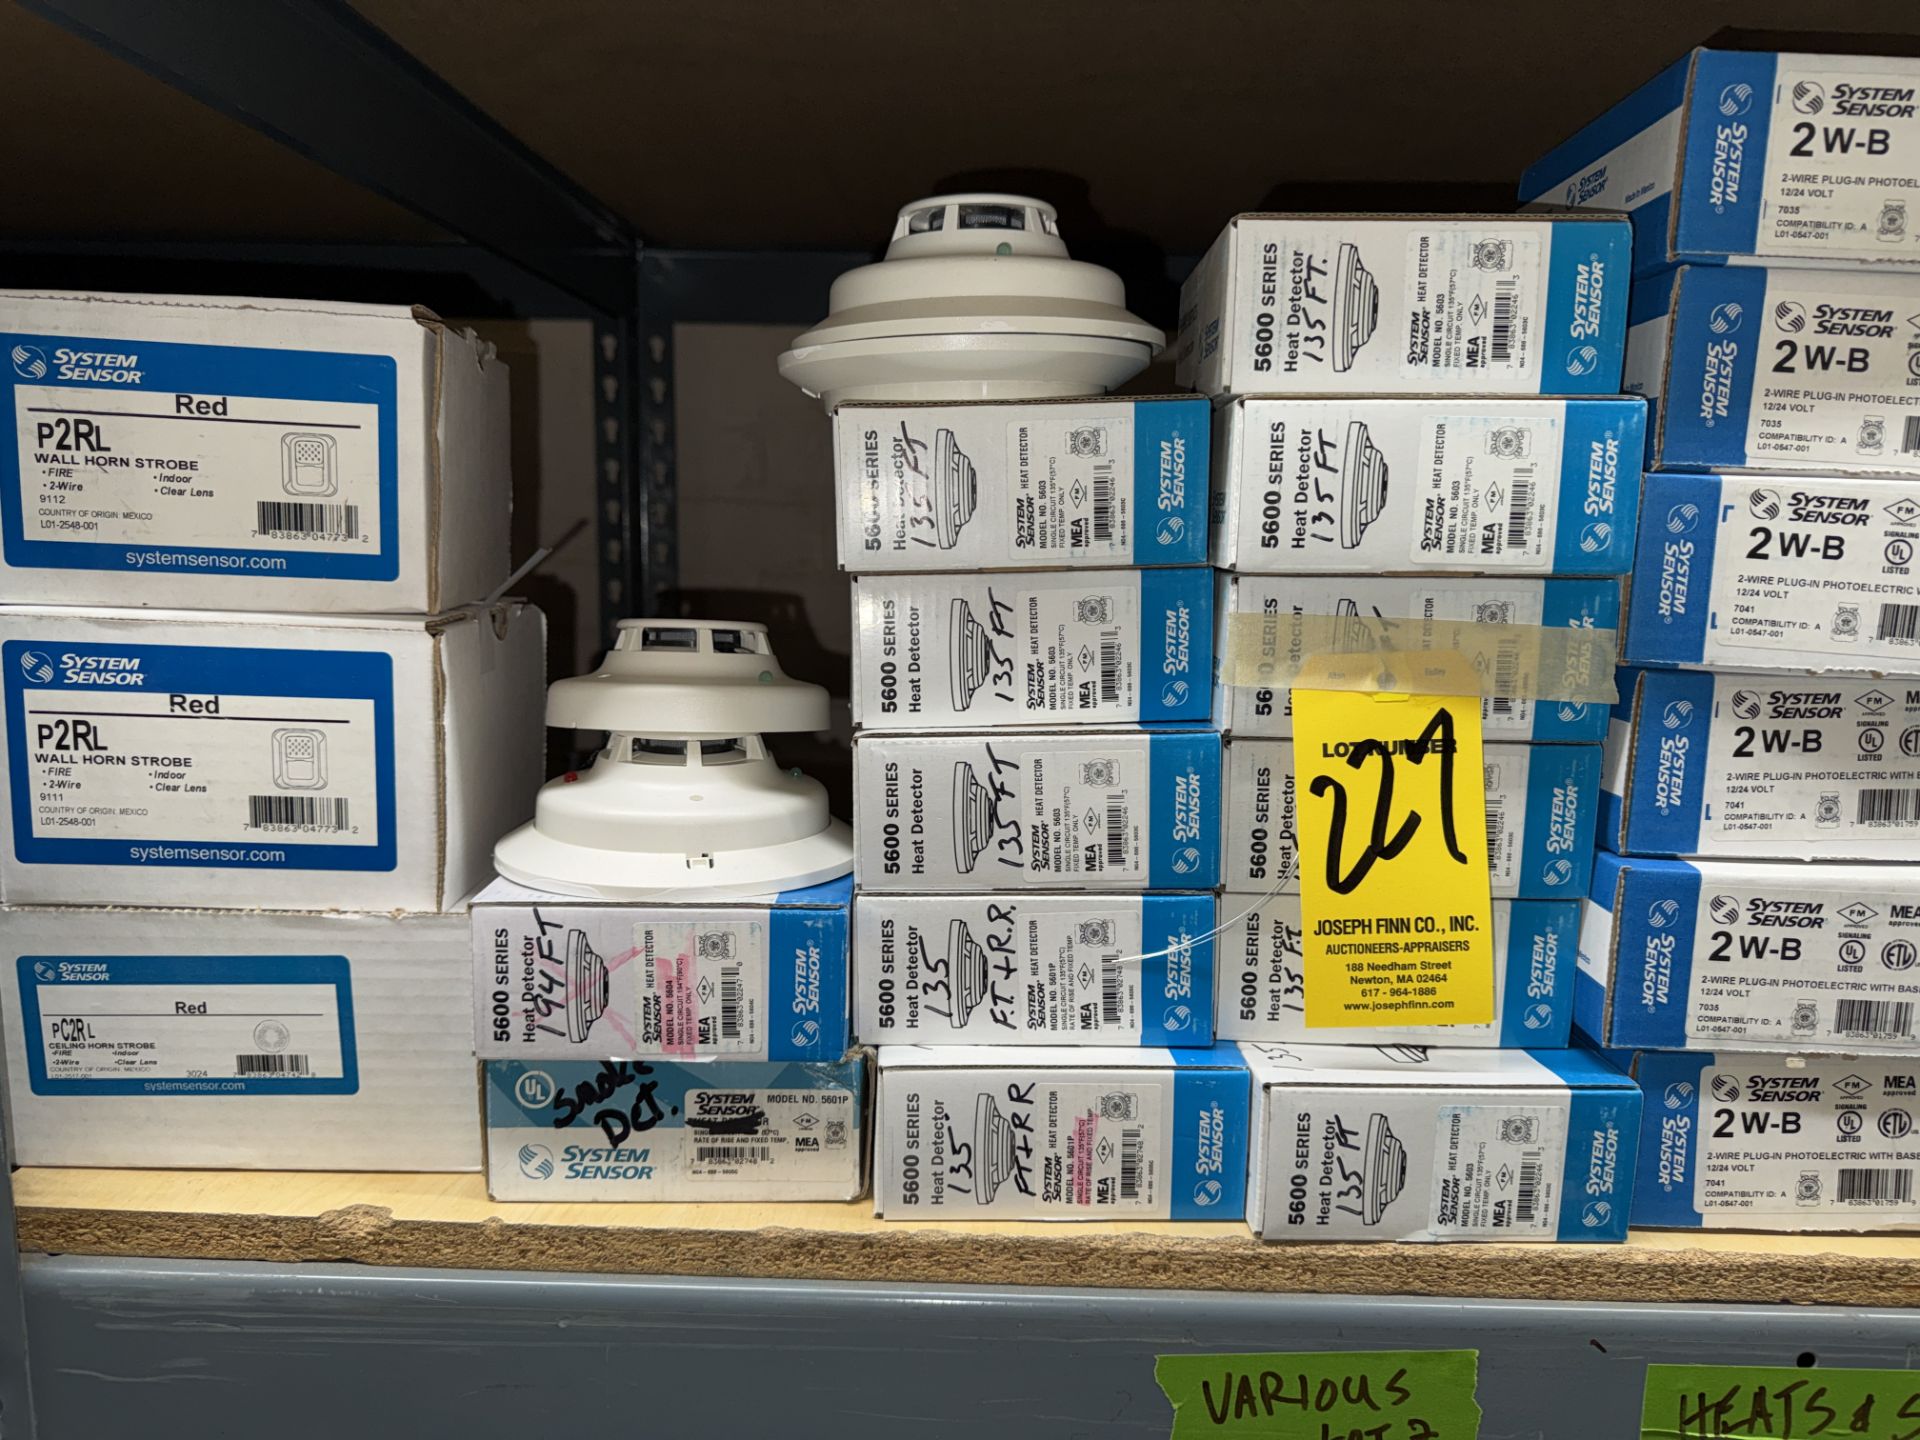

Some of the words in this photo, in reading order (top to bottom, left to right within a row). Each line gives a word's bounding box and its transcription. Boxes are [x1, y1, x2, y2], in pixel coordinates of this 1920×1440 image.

[1831, 84, 1914, 101] SYSTEM
[1832, 101, 1914, 118] SENSOR
[1260, 242, 1277, 306] SERIES
[1286, 250, 1303, 331] Detector
[1570, 263, 1589, 341] SYSTEM
[1586, 261, 1604, 338] SENSOR
[1813, 304, 1893, 322] SYSTEM
[1814, 319, 1894, 338] SENSOR
[1253, 311, 1272, 372] 5600
[1284, 336, 1299, 372] Heat
[53, 348, 139, 368] SYSTEM
[57, 365, 141, 384] SENSOR
[175, 395, 228, 416] Red
[37, 418, 111, 453] P2RL
[1313, 429, 1339, 474] FT
[34, 453, 80, 466] WALL
[85, 456, 130, 468] HORN
[135, 458, 199, 471] STROBE
[1268, 421, 1286, 484] SERIES
[1294, 428, 1311, 508] Detector
[1157, 440, 1175, 512] SYSTEM
[1173, 438, 1186, 509] SENSOR
[39, 495, 66, 505] 9112
[160, 486, 186, 497] Clear
[190, 488, 214, 498] Lens
[1788, 492, 1870, 510] SYSTEM
[38, 508, 76, 518] COUNTRY
[78, 510, 89, 518] OF
[123, 512, 152, 521] MEXICO
[1261, 489, 1279, 549] 5600
[1311, 477, 1334, 543] 135
[1788, 508, 1870, 526] SENSOR
[1292, 513, 1306, 549] Heat
[126, 550, 287, 570] systemsensor.com
[1738, 574, 1774, 585] 2-WIRE
[1777, 577, 1820, 588] PLUG-IN
[1823, 580, 1914, 595] PHOTOELECTRIC
[1734, 604, 1755, 613] 7041
[882, 600, 896, 656] SERIES
[909, 605, 920, 678] Detector
[60, 654, 140, 671] SYSTEM
[65, 668, 144, 685] SENSOR
[881, 661, 897, 714] 5600
[909, 682, 921, 713] Heat
[1767, 691, 1842, 705] SYSTEM
[169, 694, 220, 715] Red
[1769, 706, 1843, 718] SENSOR
[37, 719, 108, 752] P2RL
[35, 754, 79, 764] WALL
[82, 755, 127, 766] HORN
[131, 757, 192, 768] STROBE
[1727, 772, 1760, 781] 2-WIRE
[1763, 772, 1802, 781] PLUG-IN
[1805, 771, 1887, 781] PHOTOELECTRIC
[40, 793, 64, 802] 9111
[885, 762, 899, 819] SERIES
[911, 767, 923, 838] Detector
[1257, 767, 1271, 824] SERIES
[1309, 707, 1468, 895] 227
[130, 845, 285, 864] systemsensor.com
[884, 823, 900, 875] 5600
[911, 842, 924, 875] Heat
[1250, 828, 1266, 879] 5600
[1746, 898, 1824, 914] SYSTEM
[1748, 912, 1824, 928] SENSOR
[533, 907, 564, 966] FT
[1246, 912, 1261, 967] SERIES
[1314, 917, 1372, 936] JOSEPH
[1376, 917, 1410, 934] FINN
[1414, 917, 1444, 936] CO.,
[1450, 916, 1479, 933] INC.
[494, 928, 510, 987] SERIES
[880, 919, 895, 974] SERIES
[905, 925, 918, 993] Detector
[1271, 919, 1284, 985] Detector
[1326, 940, 1470, 955] AUCTIONEERS-APPRAISERS
[58, 962, 108, 972] SYSTEM
[61, 971, 109, 982] SENSOR
[521, 934, 535, 1006] Detector
[1345, 962, 1364, 971] 188
[1366, 960, 1416, 970] Needham
[1420, 960, 1452, 969] Street
[1350, 974, 1391, 985] Newton,
[1395, 974, 1413, 984] MA
[1416, 973, 1448, 983] 02464
[1240, 971, 1256, 1021] 5600
[1361, 988, 1379, 997] 617
[1389, 987, 1437, 996] 964-1886
[1701, 976, 1736, 985] 2-WIRE
[1739, 977, 1780, 987] PLUG-IN
[1782, 979, 1868, 992] PHOTOELECTRIC
[1870, 983, 1895, 992] WITH
[175, 1001, 207, 1014] Red
[492, 991, 511, 1042] 5600
[538, 971, 567, 1037] 194
[878, 978, 895, 1029] 5600
[906, 997, 919, 1029] Heat
[1267, 989, 1280, 1022] Heat
[1344, 999, 1455, 1011] www.josephfinn.com
[522, 1009, 536, 1043] Heat
[144, 1080, 245, 1091] systemsensor.com
[1746, 1075, 1820, 1088] SYSTEM
[1748, 1089, 1821, 1102] SENSOR
[1884, 1076, 1916, 1089] MEA
[694, 1092, 755, 1105] SYSTEM
[697, 1103, 756, 1115] SENSOR
[767, 1095, 797, 1104] MODEL
[800, 1095, 818, 1104] NO.
[821, 1095, 849, 1104] 5601P
[906, 1093, 920, 1150] SERIES
[931, 1100, 945, 1169] Detector
[561, 1145, 650, 1163] SYSTEM
[795, 1137, 819, 1147] MEA
[1297, 1113, 1311, 1169] SERIES
[1319, 1120, 1336, 1189] Detector
[1707, 1152, 1740, 1160] 2-WIRE
[1743, 1152, 1781, 1160] PLUG-IN
[1784, 1152, 1866, 1160] PHOTOELECTRIC
[1869, 1152, 1893, 1160] WITH
[568, 1164, 654, 1180] SENSOR
[903, 1154, 920, 1206] 5600
[932, 1173, 944, 1206] Heat
[1288, 1174, 1307, 1225] 5600
[1317, 1193, 1330, 1226] Heat
[1202, 1368, 1411, 1425] VARIOUS
[1678, 1380, 1836, 1440] HEATS
